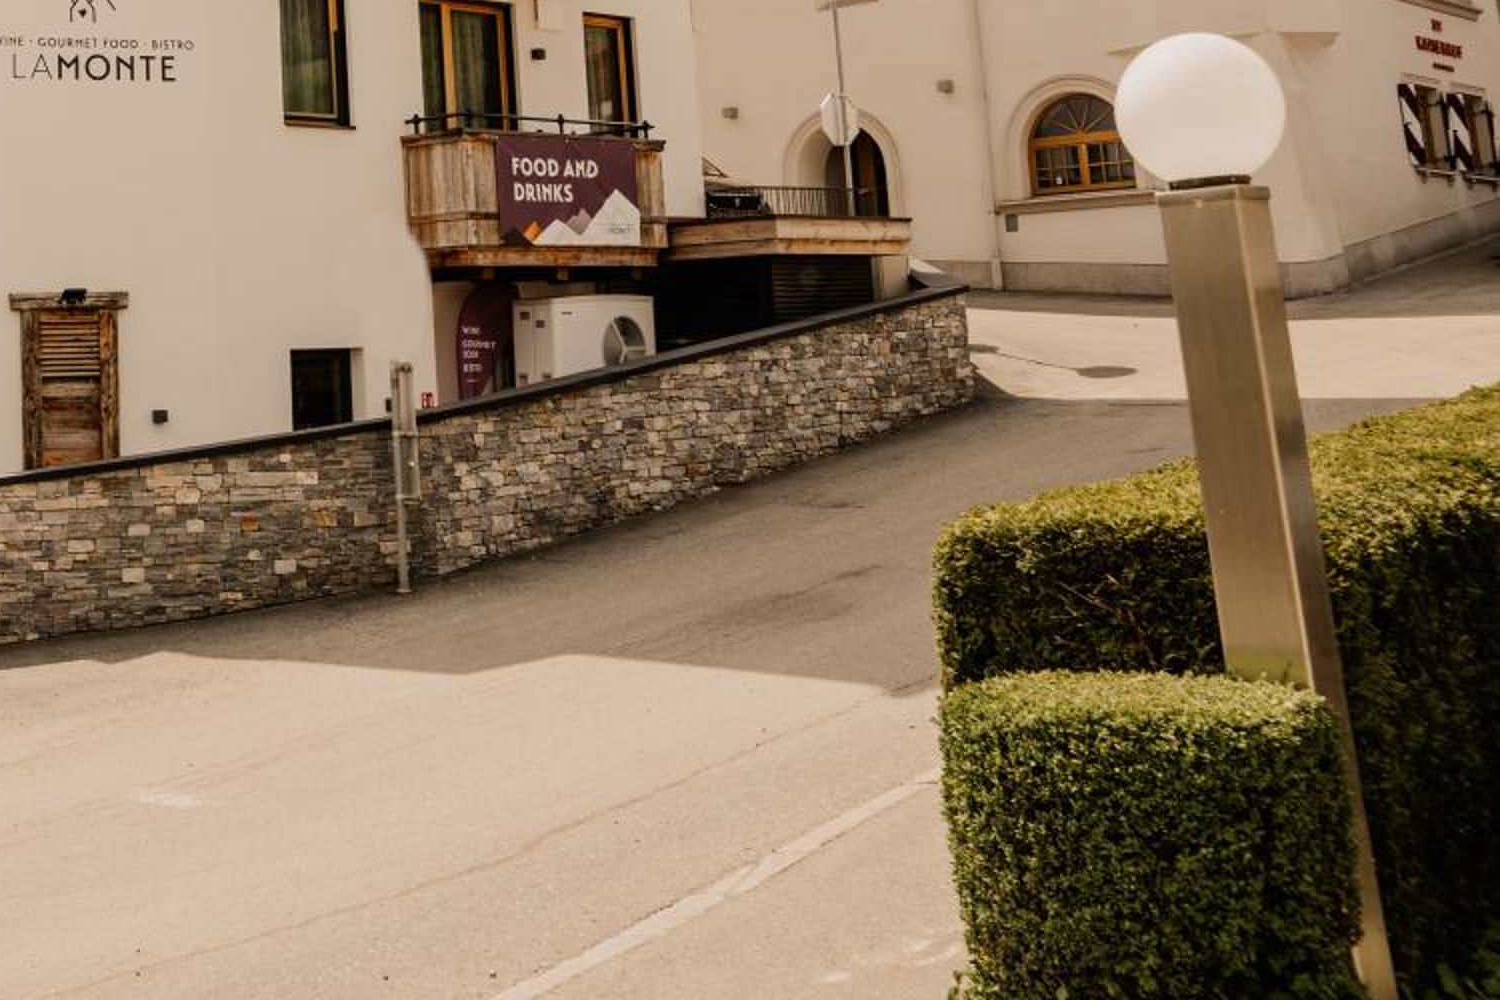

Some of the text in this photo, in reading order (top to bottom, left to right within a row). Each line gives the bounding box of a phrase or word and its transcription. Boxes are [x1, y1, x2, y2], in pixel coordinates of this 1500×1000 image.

[37, 37, 97, 49] GOURMET
[103, 39, 139, 49] FOOD
[151, 39, 195, 51] BISTRO
[12, 53, 177, 82] LAMONTE
[511, 156, 599, 179] FOOD AND
[513, 181, 575, 203] DRINKS
